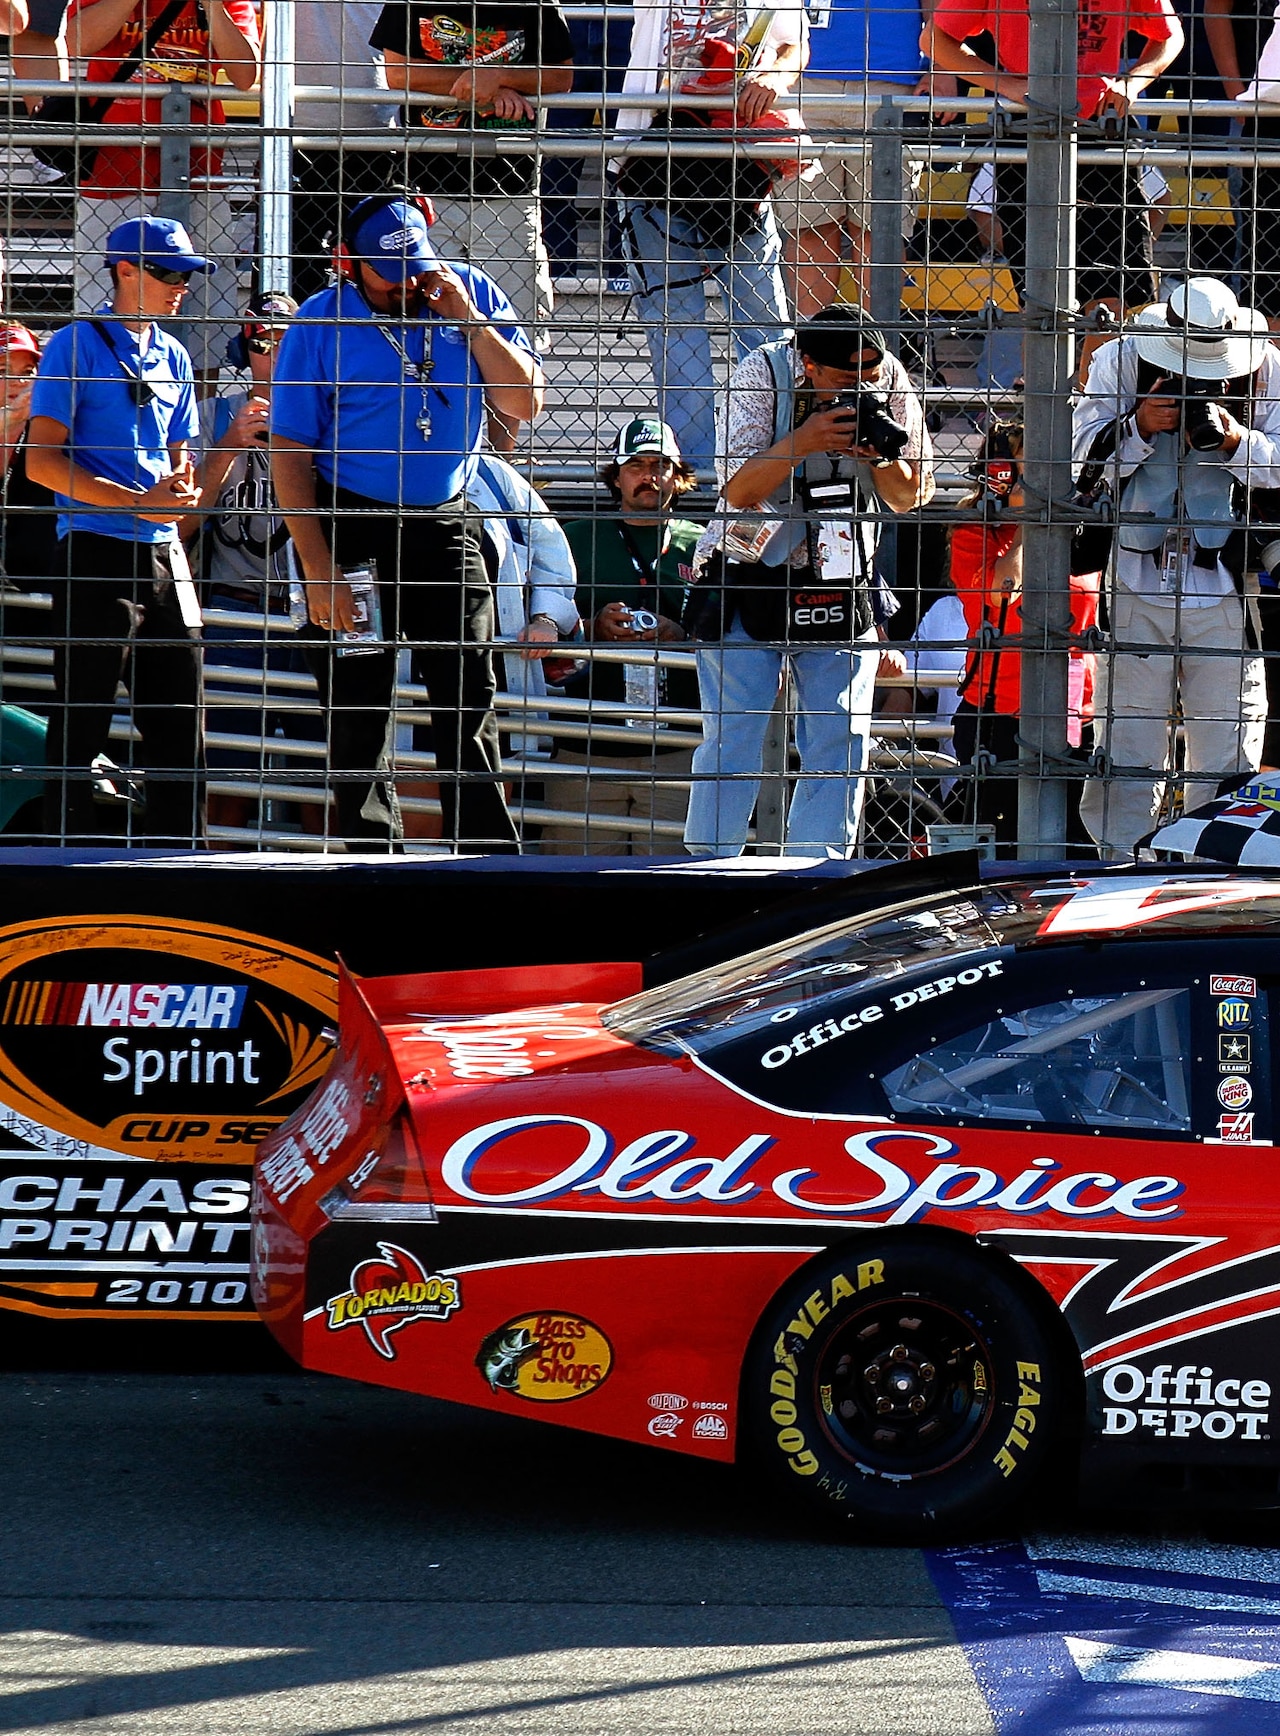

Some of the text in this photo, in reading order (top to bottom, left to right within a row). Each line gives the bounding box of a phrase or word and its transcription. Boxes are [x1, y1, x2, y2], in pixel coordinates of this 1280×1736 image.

[795, 592, 843, 605] Canon
[795, 605, 844, 626] EOS
[77, 984, 236, 1029] NASCAR
[761, 960, 1003, 1070] Office DEPOT
[1219, 1002, 1250, 1027] RITZ
[103, 1037, 260, 1095] Sprint
[1223, 1091, 1248, 1102] KING
[121, 1121, 209, 1143] CUP
[441, 1114, 1184, 1228] Old Spice
[0, 1219, 251, 1253] PRINT
[106, 1279, 247, 1304] 2010
[331, 1279, 455, 1324] TORNADOS
[534, 1316, 587, 1339] Bass
[537, 1336, 577, 1359] Pro
[534, 1357, 601, 1388] Shops
[1103, 1365, 1271, 1408] Office
[700, 1402, 728, 1410] BOSCH
[994, 1360, 1042, 1478] EAGLE
[695, 1416, 726, 1431] MAC
[1103, 1408, 1268, 1440] DEPOT
